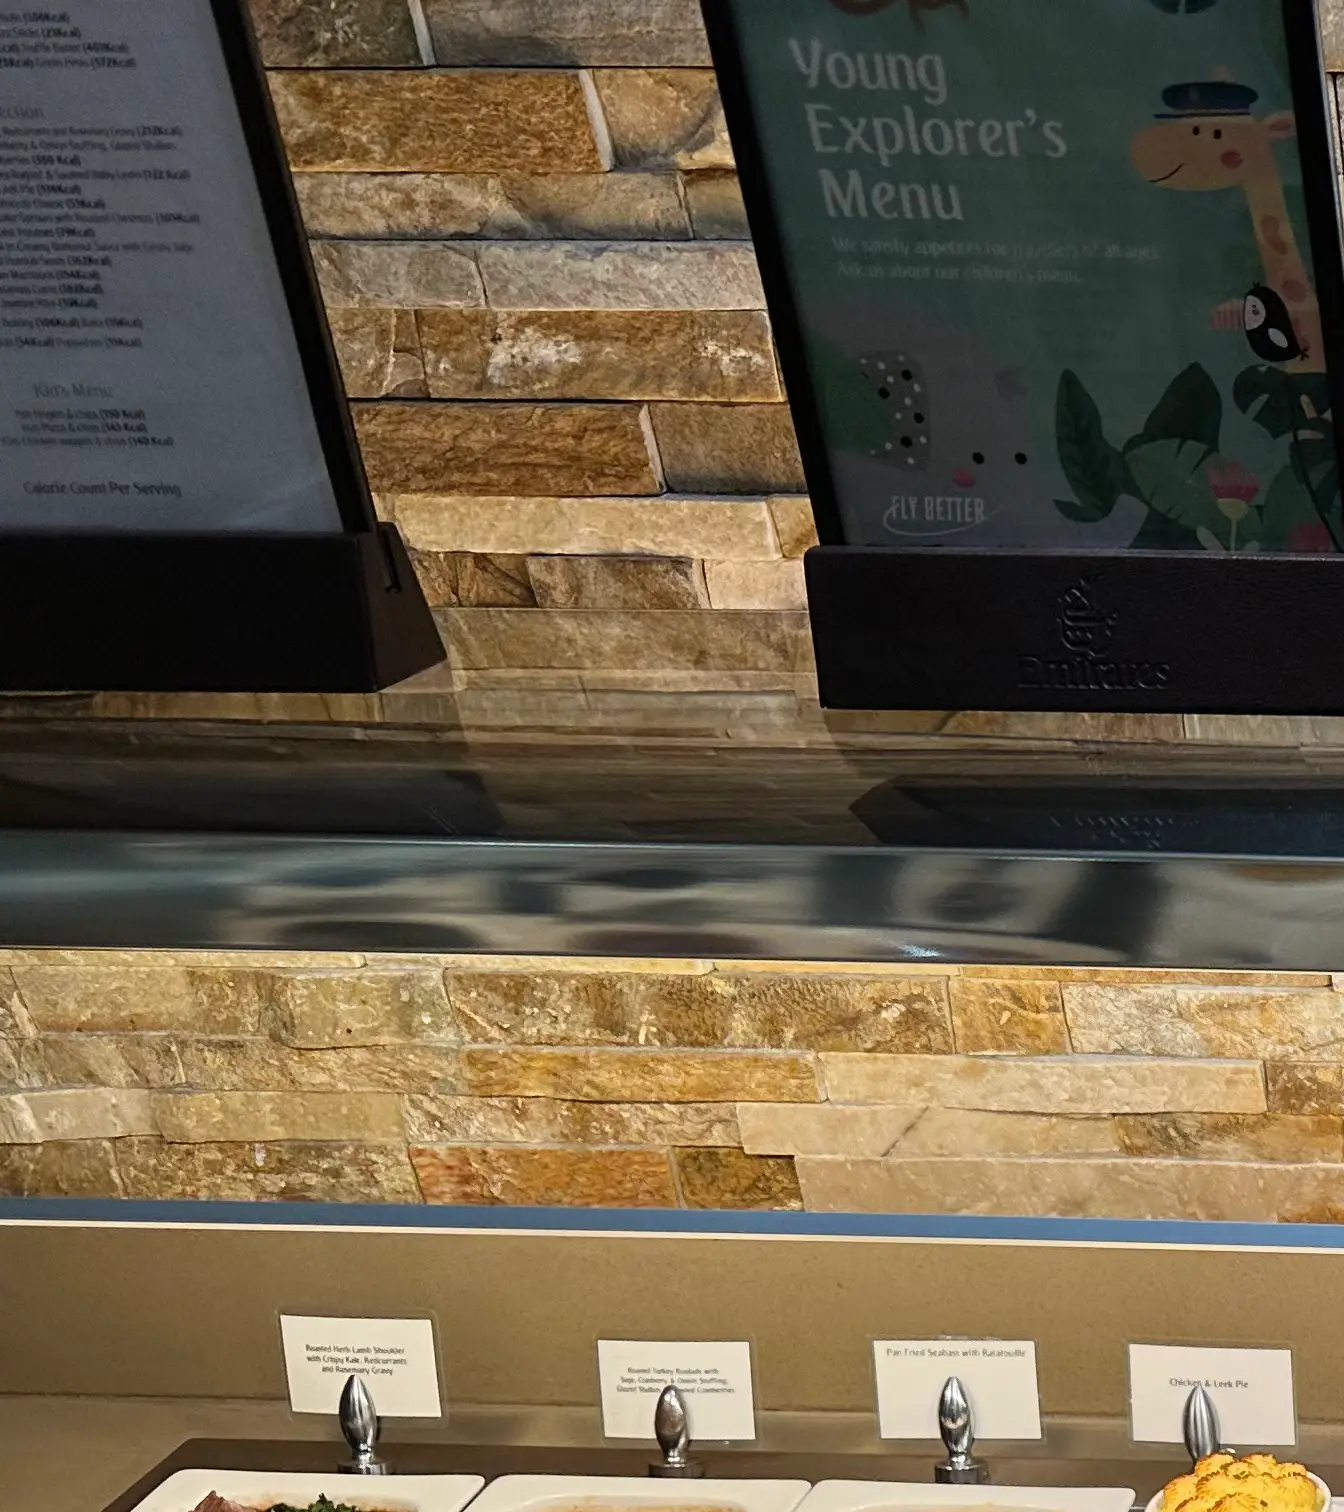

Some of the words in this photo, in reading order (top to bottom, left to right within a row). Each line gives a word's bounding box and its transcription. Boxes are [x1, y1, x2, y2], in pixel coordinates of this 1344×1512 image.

[788, 36, 948, 107] Young
[804, 102, 1067, 168] Explorer's
[817, 168, 965, 222] Menu
[23, 480, 68, 495] Calorie
[70, 481, 106, 495] Count
[109, 481, 130, 494] Per
[133, 482, 183, 498] Serving
[890, 494, 919, 521] FLY
[924, 495, 986, 524] BETTER
[886, 1348, 902, 1357] Pan
[904, 1348, 925, 1357] Fried
[962, 1348, 980, 1357] with
[1213, 1379, 1233, 1388] Leek
[1235, 1379, 1249, 1388] Pie
